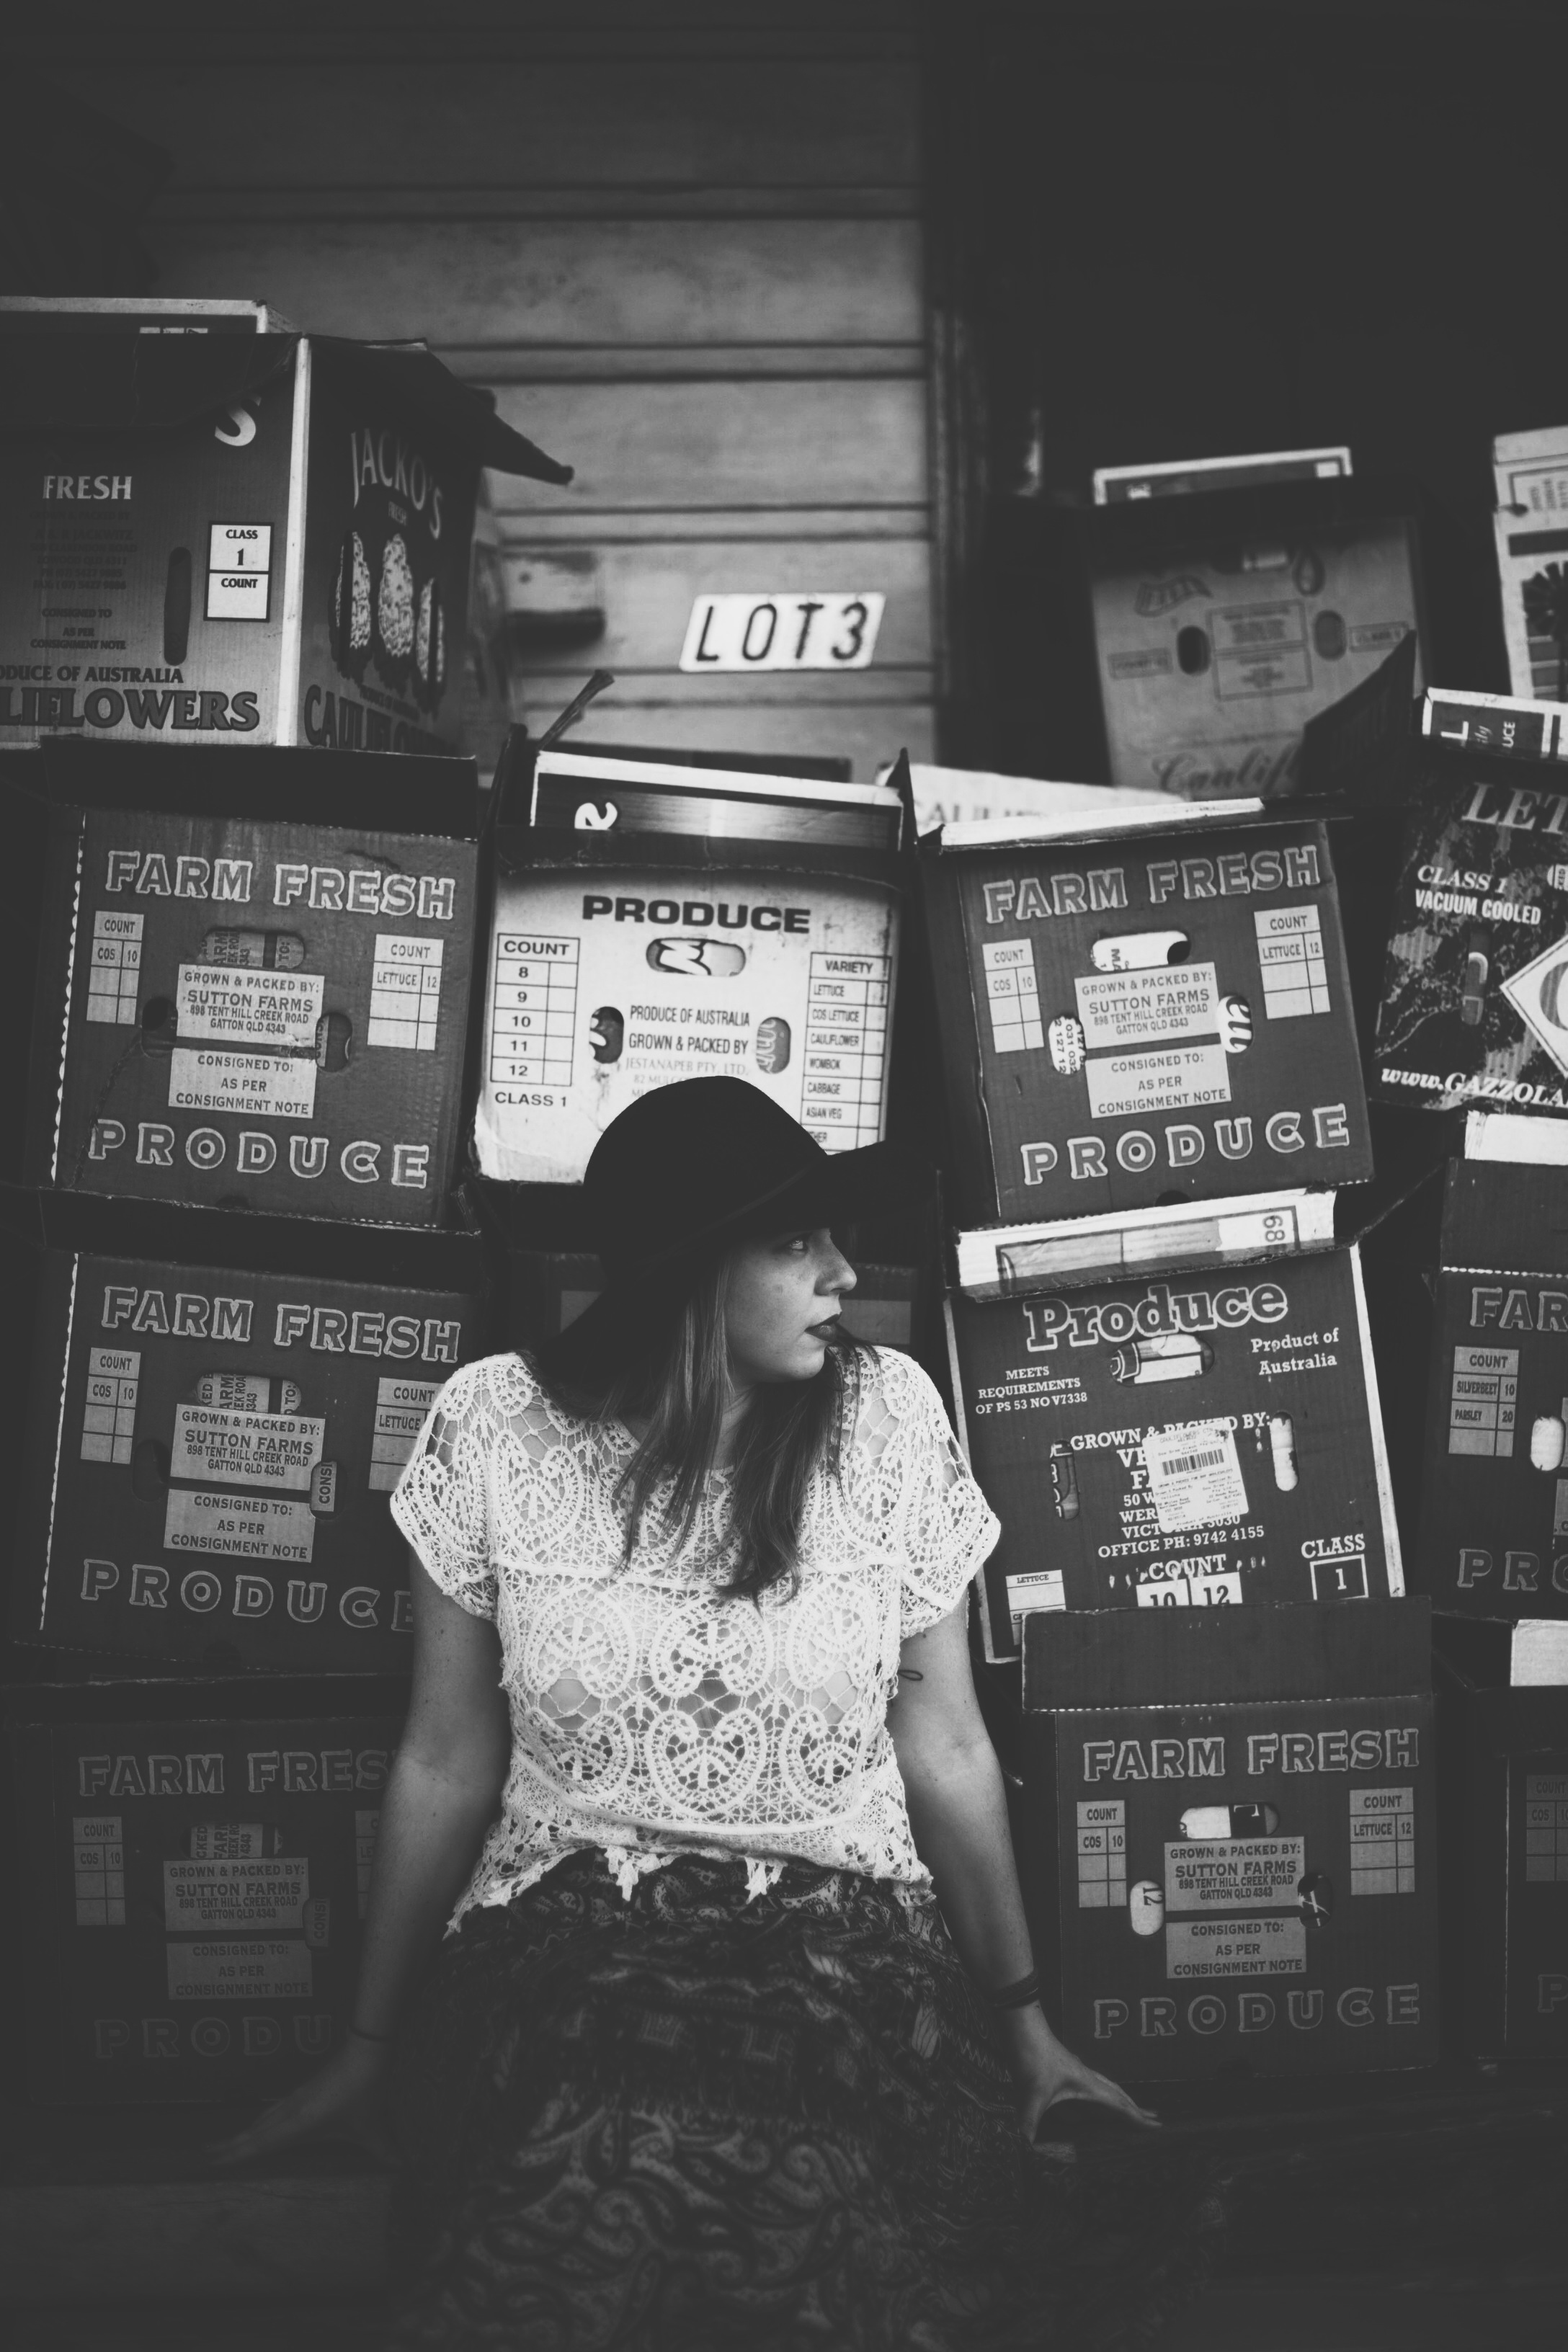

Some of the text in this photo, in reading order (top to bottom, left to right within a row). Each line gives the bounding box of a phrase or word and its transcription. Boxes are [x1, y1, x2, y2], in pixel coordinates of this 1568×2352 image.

[43, 476, 133, 499] FRESH
[226, 530, 257, 540] CLASS
[221, 579, 257, 589] COUNT
[57, 667, 80, 681] OF
[85, 667, 183, 683] AUSTRALIA
[106, 850, 455, 919] FARM FRESH
[984, 845, 1322, 924] FARM FRESH
[1417, 865, 1493, 891] CLASS
[582, 896, 811, 934] PRODUCE
[1416, 889, 1541, 925] VACUUM COOLED
[104, 919, 135, 934] COUNT
[1270, 915, 1307, 930] COUNT
[97, 948, 115, 960] COS
[391, 944, 430, 959] COUNT
[504, 940, 570, 956] COUNT
[994, 948, 1024, 963] COUNT
[1262, 943, 1301, 959] LETTUCE
[184, 971, 319, 993] GROWN PACKED BY:
[377, 971, 417, 986] LETTUCE
[994, 979, 1011, 992] COS
[1082, 972, 1211, 996] GROWN PACKED BY:
[187, 989, 313, 1012] SUTTON FARMS
[1089, 988, 1210, 1015] SUTTON FARMS
[207, 1005, 308, 1024] TENT HILL CREEK ROAD
[630, 1005, 750, 1027] PRODUCE AUSTRALIA
[1111, 1003, 1208, 1023] TENT HILL CREEK ROAD
[210, 1018, 285, 1035] GATTON QLD 4343
[1116, 1017, 1189, 1035] GATTON QLD 4343
[629, 1033, 731, 1054] GROWN PACKED
[197, 1055, 293, 1072] CONSIGNED TO:
[808, 1058, 841, 1070] WOMBOK
[1111, 1053, 1204, 1073] CONSIGNED TO:
[242, 1080, 267, 1092] PER
[808, 1082, 840, 1095] CABBAGE
[1158, 1075, 1182, 1089] PER
[177, 1092, 308, 1115] CONSIGNMENT NOTE
[494, 1092, 553, 1107] CLASS
[1098, 1089, 1226, 1114] CONSIGNMENT NOTE
[806, 1107, 842, 1120] ASIAN VEG
[1020, 1103, 1350, 1186] PRODUCE
[88, 1118, 429, 1189] PRODUCE
[102, 1286, 462, 1363] FARM FRESH
[1023, 1283, 1288, 1353] Produce
[1250, 1327, 1339, 1353] Product of
[100, 1355, 132, 1371] COUNT
[1258, 1353, 1337, 1376] Australia
[1469, 1355, 1508, 1368] COUNT
[1005, 1366, 1050, 1381] MEETS
[93, 1384, 111, 1398] COS
[394, 1387, 435, 1402] COUNT
[978, 1377, 1081, 1399] REQUIREMENTS
[976, 1392, 1088, 1415] OF PS NO V7338
[182, 1412, 320, 1435] GROWN PACKED BY:
[379, 1415, 421, 1431] LETTUCE
[184, 1430, 313, 1456] SUTTON FARMS
[1070, 1428, 1141, 1451] GROWN
[194, 1496, 292, 1515] CONSIGNED TO:
[171, 1534, 308, 1559] CONSIGNMENT NOTE
[1098, 1525, 1264, 1557] OFFICE PH: 9742 4155
[1301, 1534, 1366, 1559] CLASS
[1149, 1554, 1226, 1580] COUNT
[1017, 1574, 1049, 1584] LETTUCE
[1083, 1728, 1420, 1783] FARM FRESH
[79, 1754, 224, 1796] FARM
[1364, 1795, 1402, 1809] COUNT
[1087, 1808, 1118, 1821] COUNT
[84, 1825, 115, 1837] COUNT
[1354, 1823, 1392, 1837] LETTUCE
[1083, 1836, 1101, 1848] COS
[80, 1853, 99, 1865] COS
[1170, 1844, 1301, 1859] GROWN PACKED BY:
[1175, 1861, 1297, 1879] SUTTON FARMS
[176, 1882, 301, 1897] SUTTON FARMS
[1196, 1875, 1293, 1888] TENT HILL CREEK ROAD
[1200, 1887, 1273, 1899] GATTON QLD 4343
[1191, 1922, 1284, 1936] CONSIGNED TO:
[192, 1944, 289, 1956] CONSIGNED TO:
[1237, 1943, 1261, 1954] PER
[1174, 1959, 1303, 1975] CONSIGNMENT NOTE
[176, 1982, 308, 1996] CONSIGNMENT NOTE
[1094, 1983, 1420, 2039] PRODUCE
